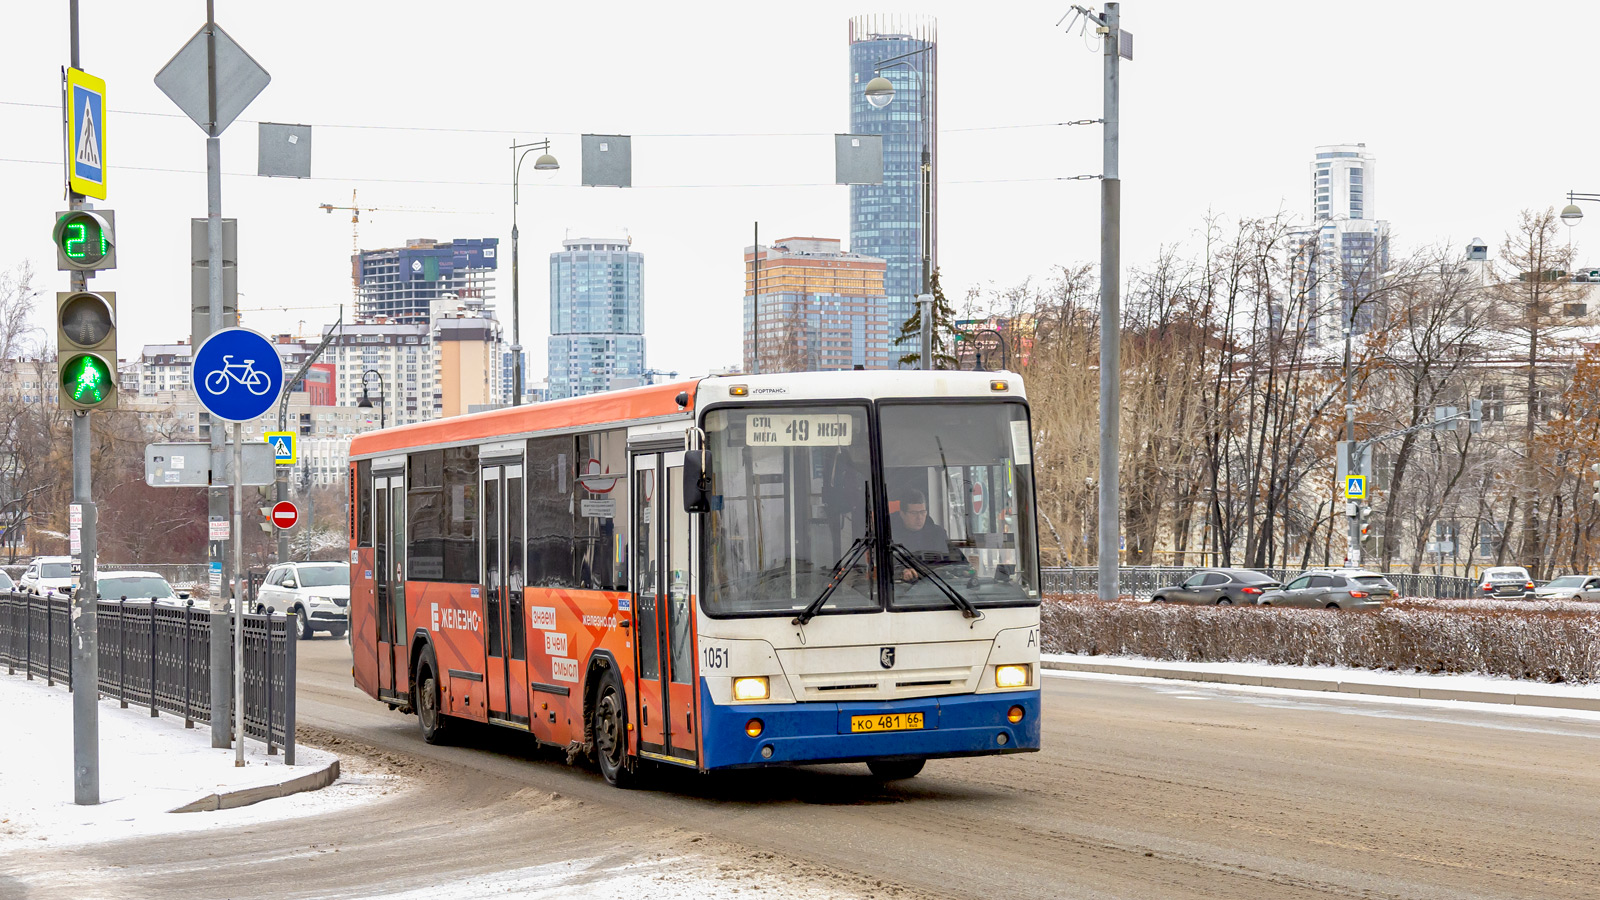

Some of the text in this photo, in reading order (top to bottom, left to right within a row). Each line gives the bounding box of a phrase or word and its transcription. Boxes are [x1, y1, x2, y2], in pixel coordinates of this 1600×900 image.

[67, 223, 107, 258] 21
[752, 417, 772, 429] СТЦ
[785, 419, 847, 442] 49 ЖБИ
[753, 431, 777, 443] МЕГА
[440, 607, 479, 632] ЖЕЛЕЗНО
[533, 610, 555, 626] знаем
[582, 613, 618, 632] железно.рф
[552, 636, 567, 652] чем
[703, 646, 729, 669] 1051
[553, 660, 578, 678] смысл
[877, 715, 900, 729] 481
[907, 713, 919, 724] 66
